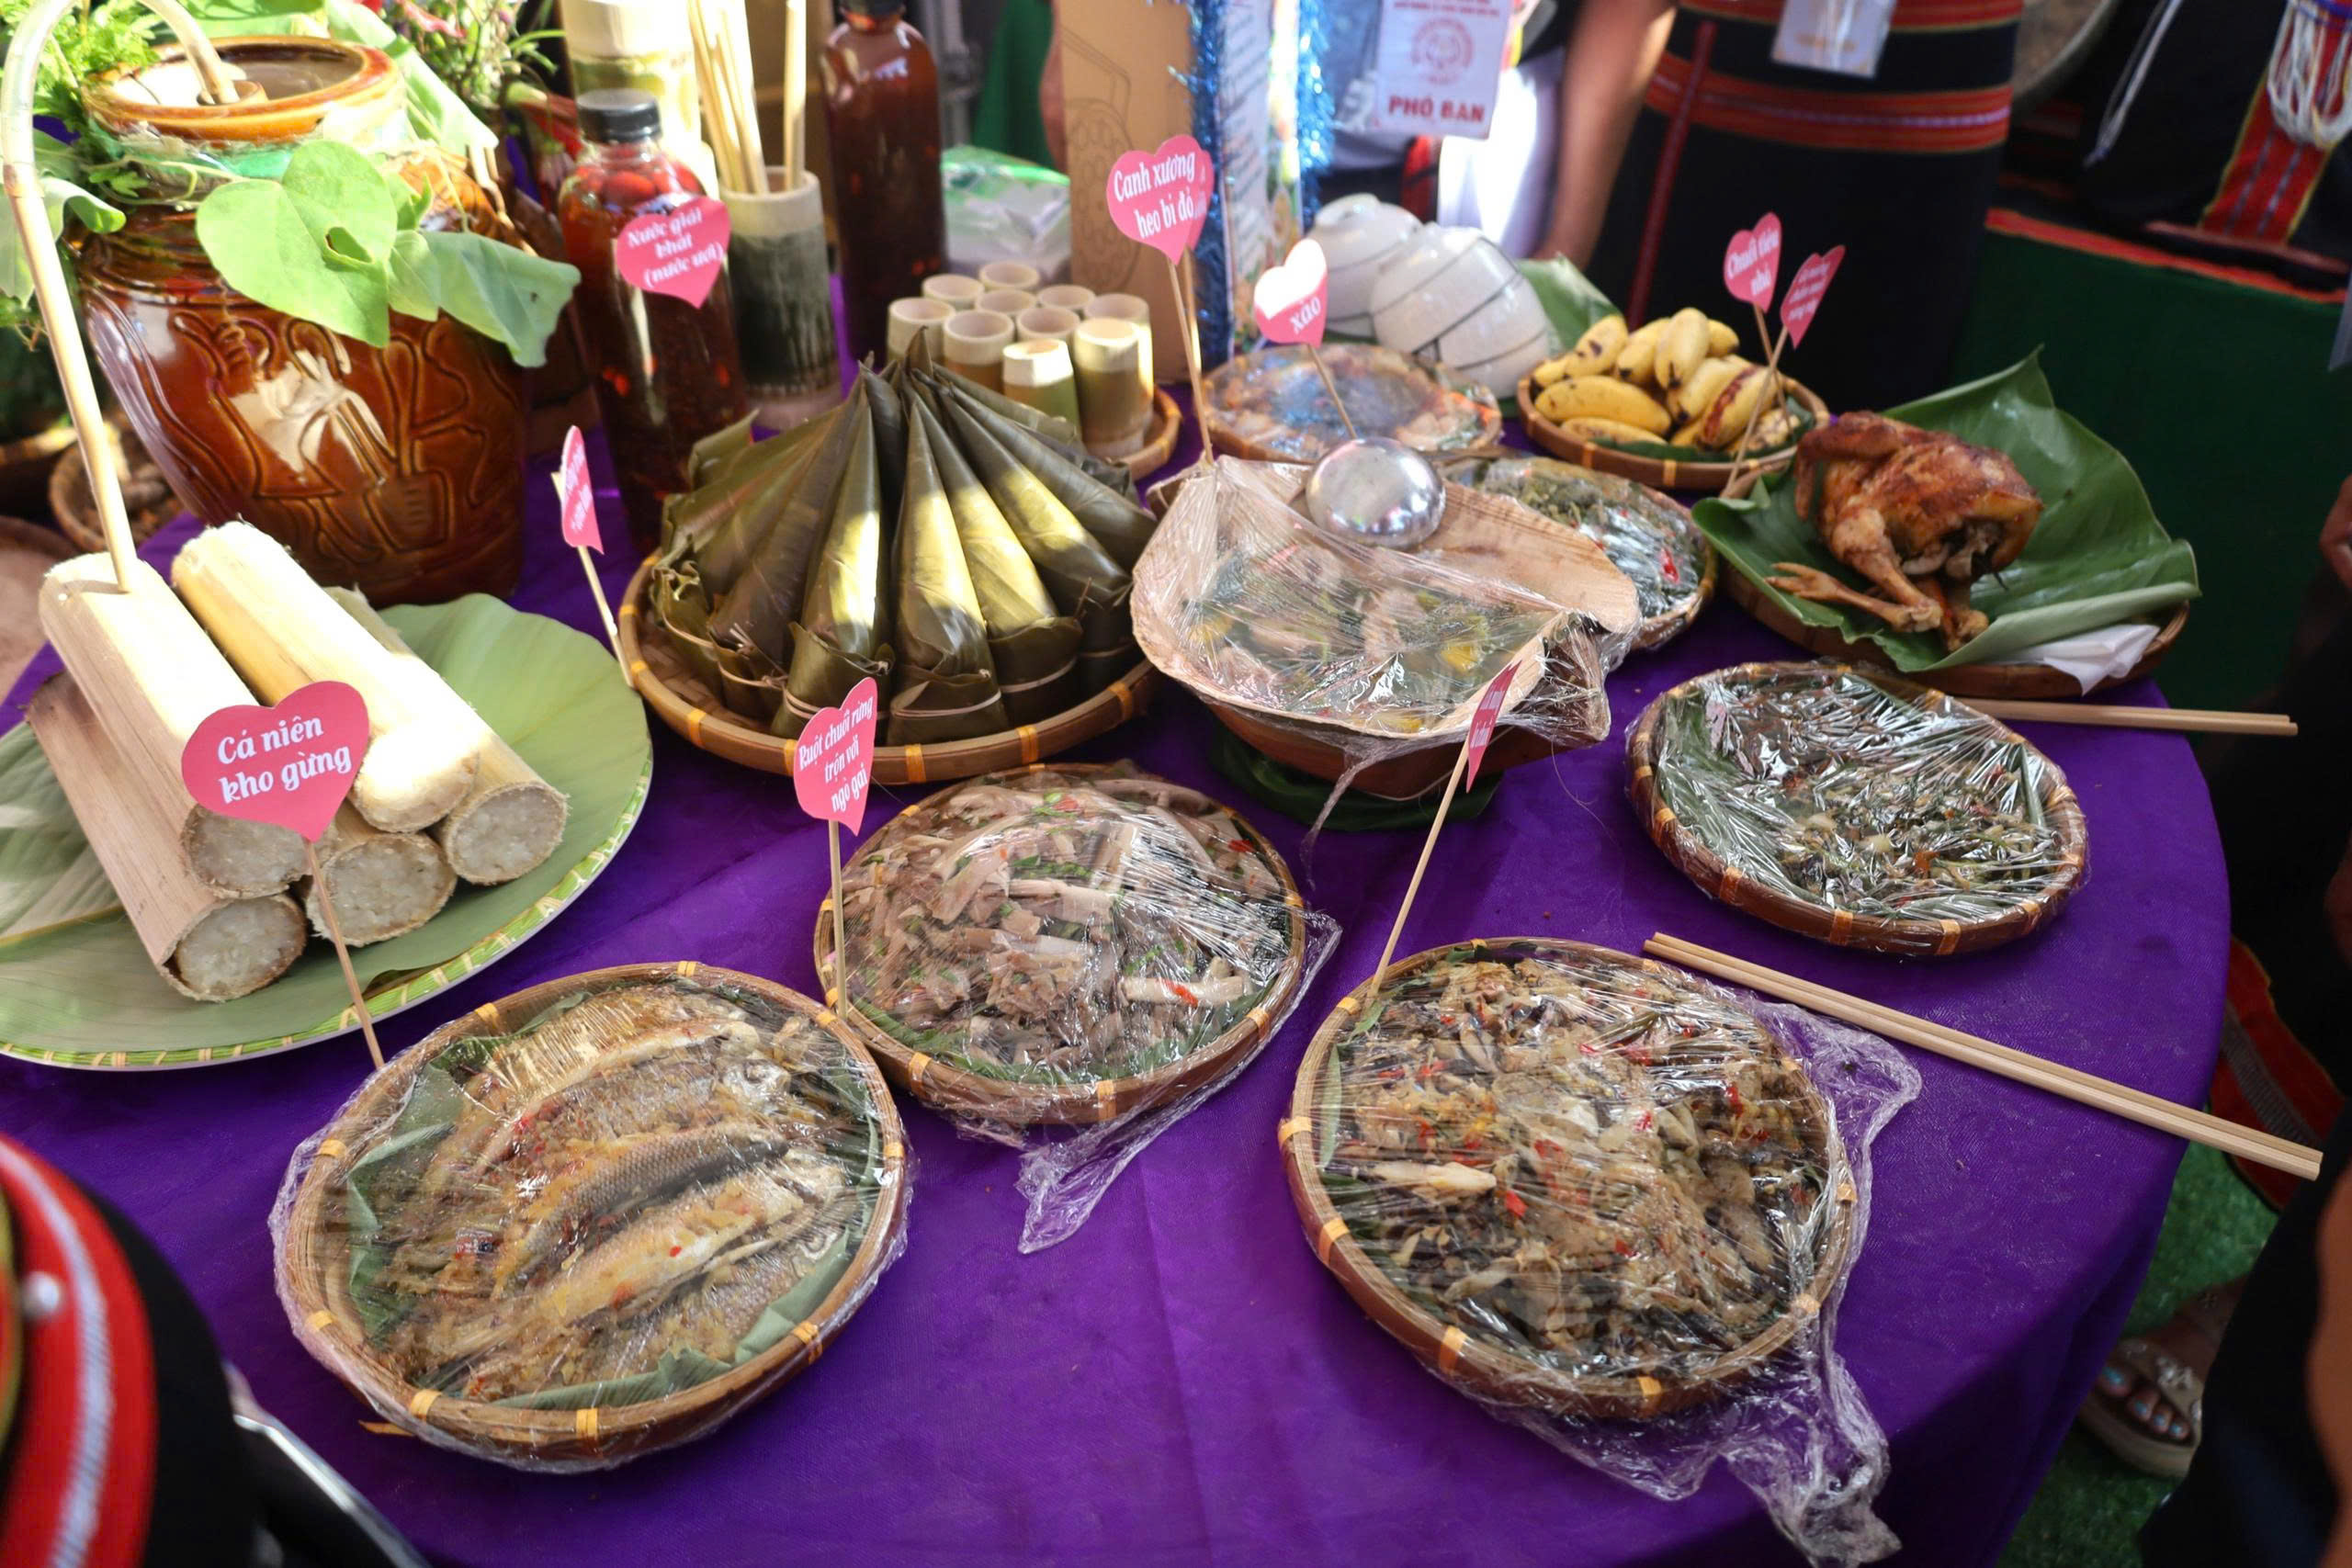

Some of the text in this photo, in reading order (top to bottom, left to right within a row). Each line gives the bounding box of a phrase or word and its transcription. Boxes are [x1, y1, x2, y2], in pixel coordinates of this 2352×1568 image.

[1114, 162, 1152, 202] Canh
[1152, 152, 1195, 188] xương
[628, 221, 668, 248] Nước
[1133, 208, 1161, 239] heo
[218, 716, 324, 764] Cá niên
[798, 734, 824, 772] Ruột
[851, 695, 874, 728] rừng
[824, 733, 860, 784] trộn với
[218, 746, 353, 805] kho gừng
[831, 763, 868, 813] ngò gai
